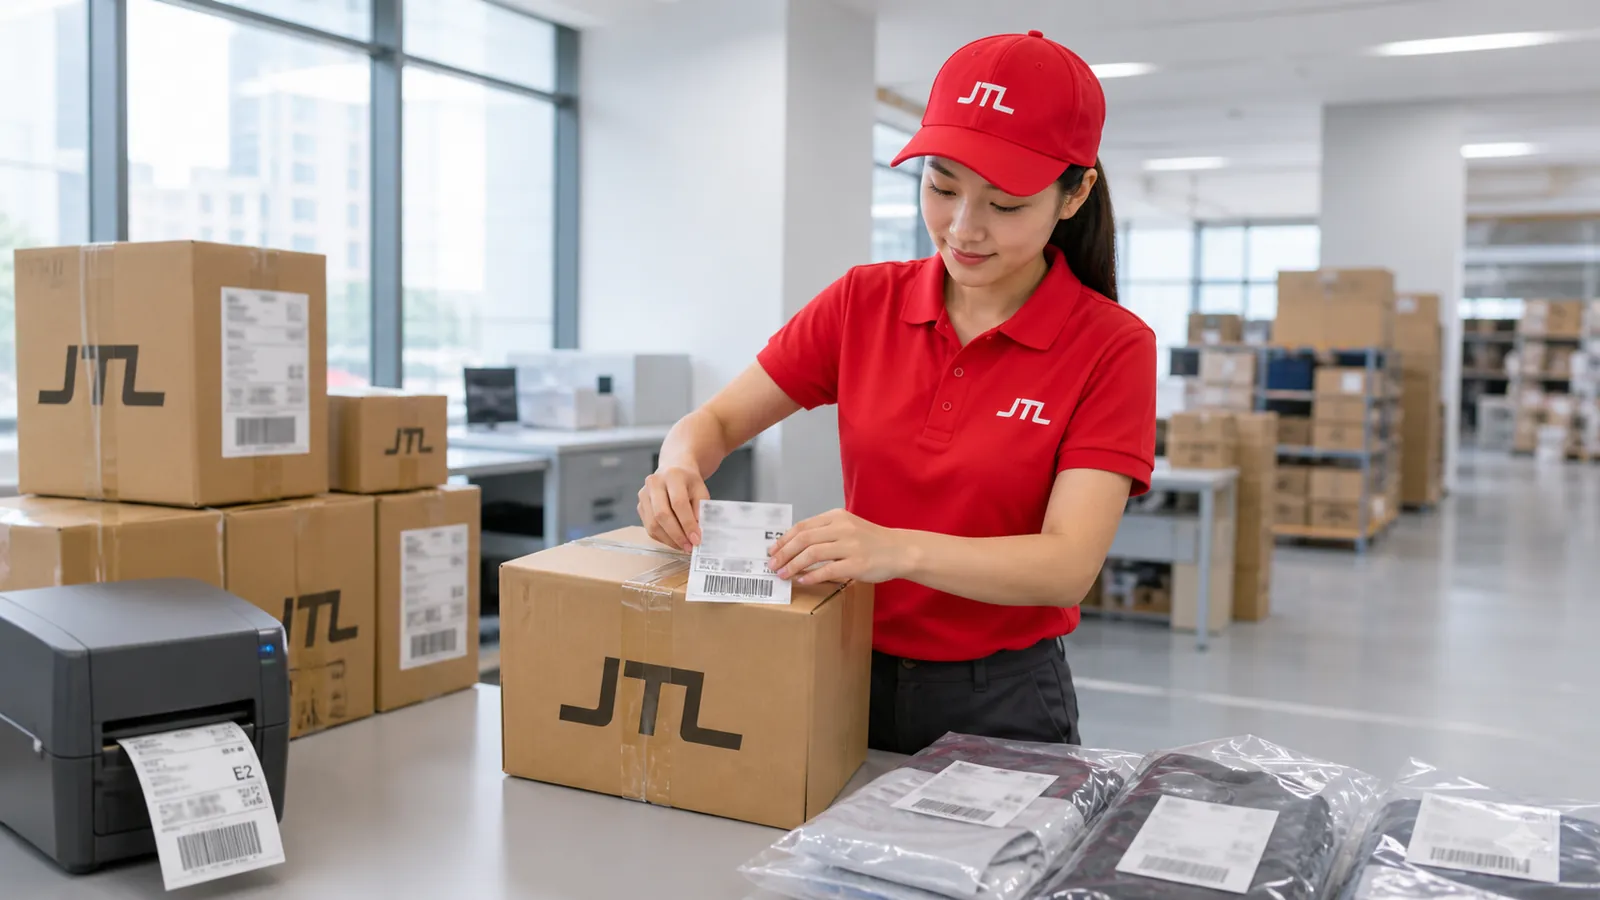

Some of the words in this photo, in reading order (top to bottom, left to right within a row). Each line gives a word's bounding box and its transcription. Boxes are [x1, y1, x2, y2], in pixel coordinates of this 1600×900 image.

[957, 81, 1015, 115] JTL
[38, 345, 165, 407] JTL
[996, 398, 1051, 425] JTL
[384, 428, 433, 455] JTL
[559, 656, 743, 750] JTL
[233, 765, 255, 780] E2
